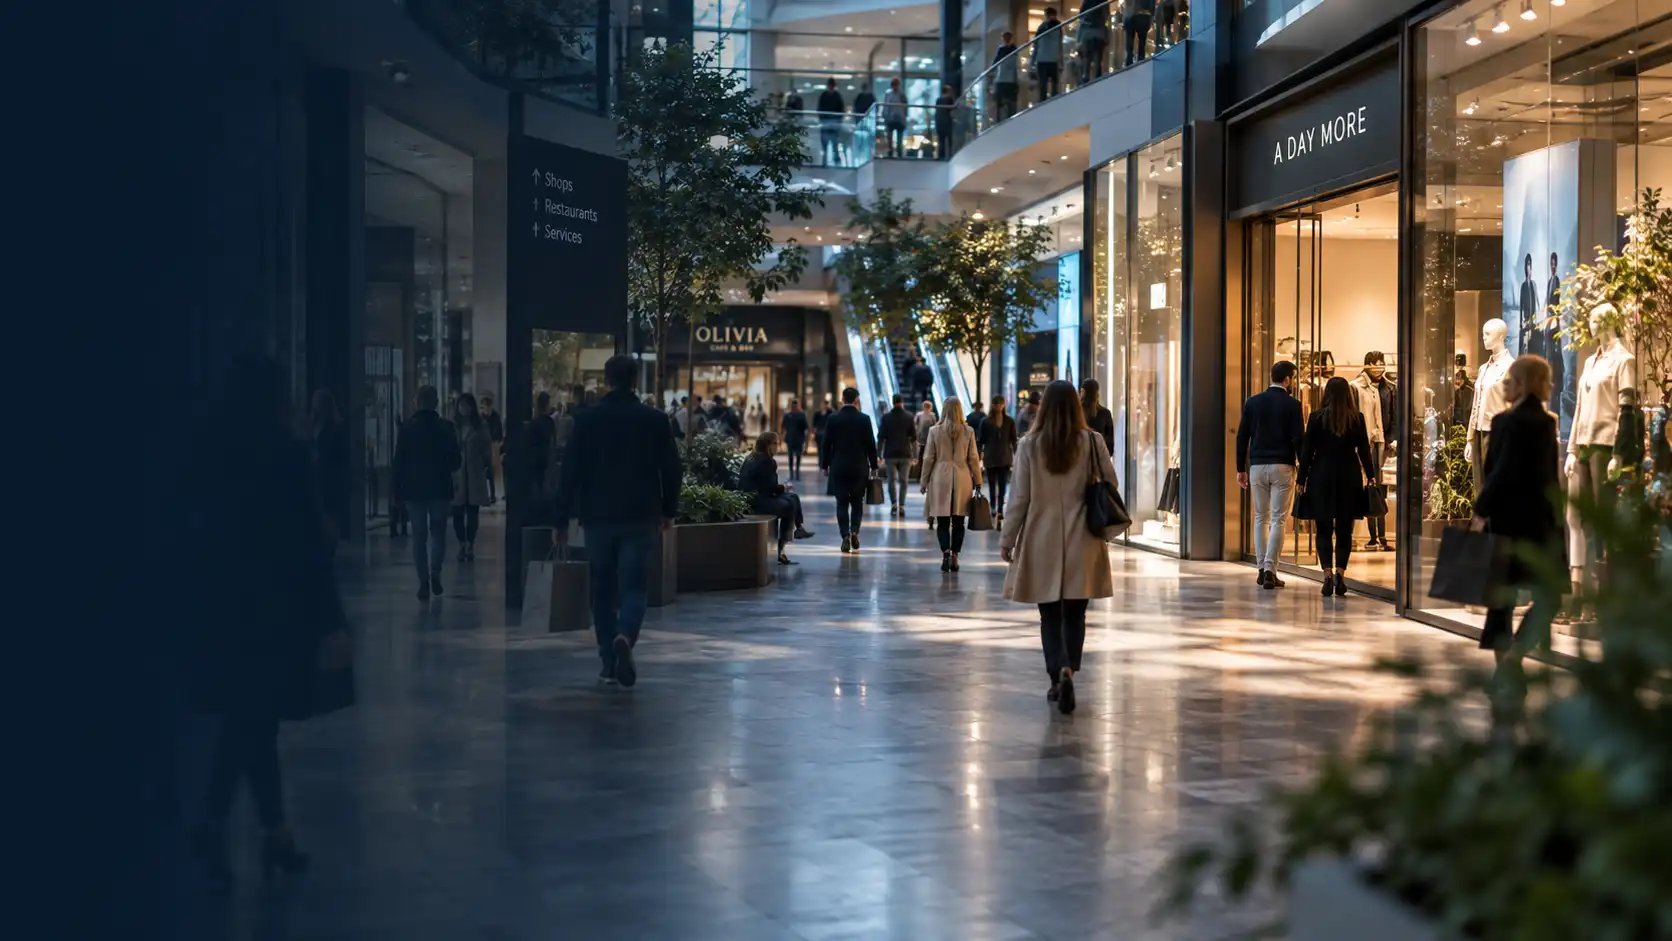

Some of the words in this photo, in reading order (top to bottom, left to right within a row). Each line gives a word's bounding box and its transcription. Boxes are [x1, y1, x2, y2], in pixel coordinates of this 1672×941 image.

[1273, 141, 1283, 165] A
[1287, 127, 1315, 160] DAY
[1321, 106, 1367, 147] MORE
[545, 171, 574, 193] Shops
[545, 198, 598, 222] Restaurants
[544, 224, 583, 244] Services
[696, 326, 768, 343] OLIVIA
